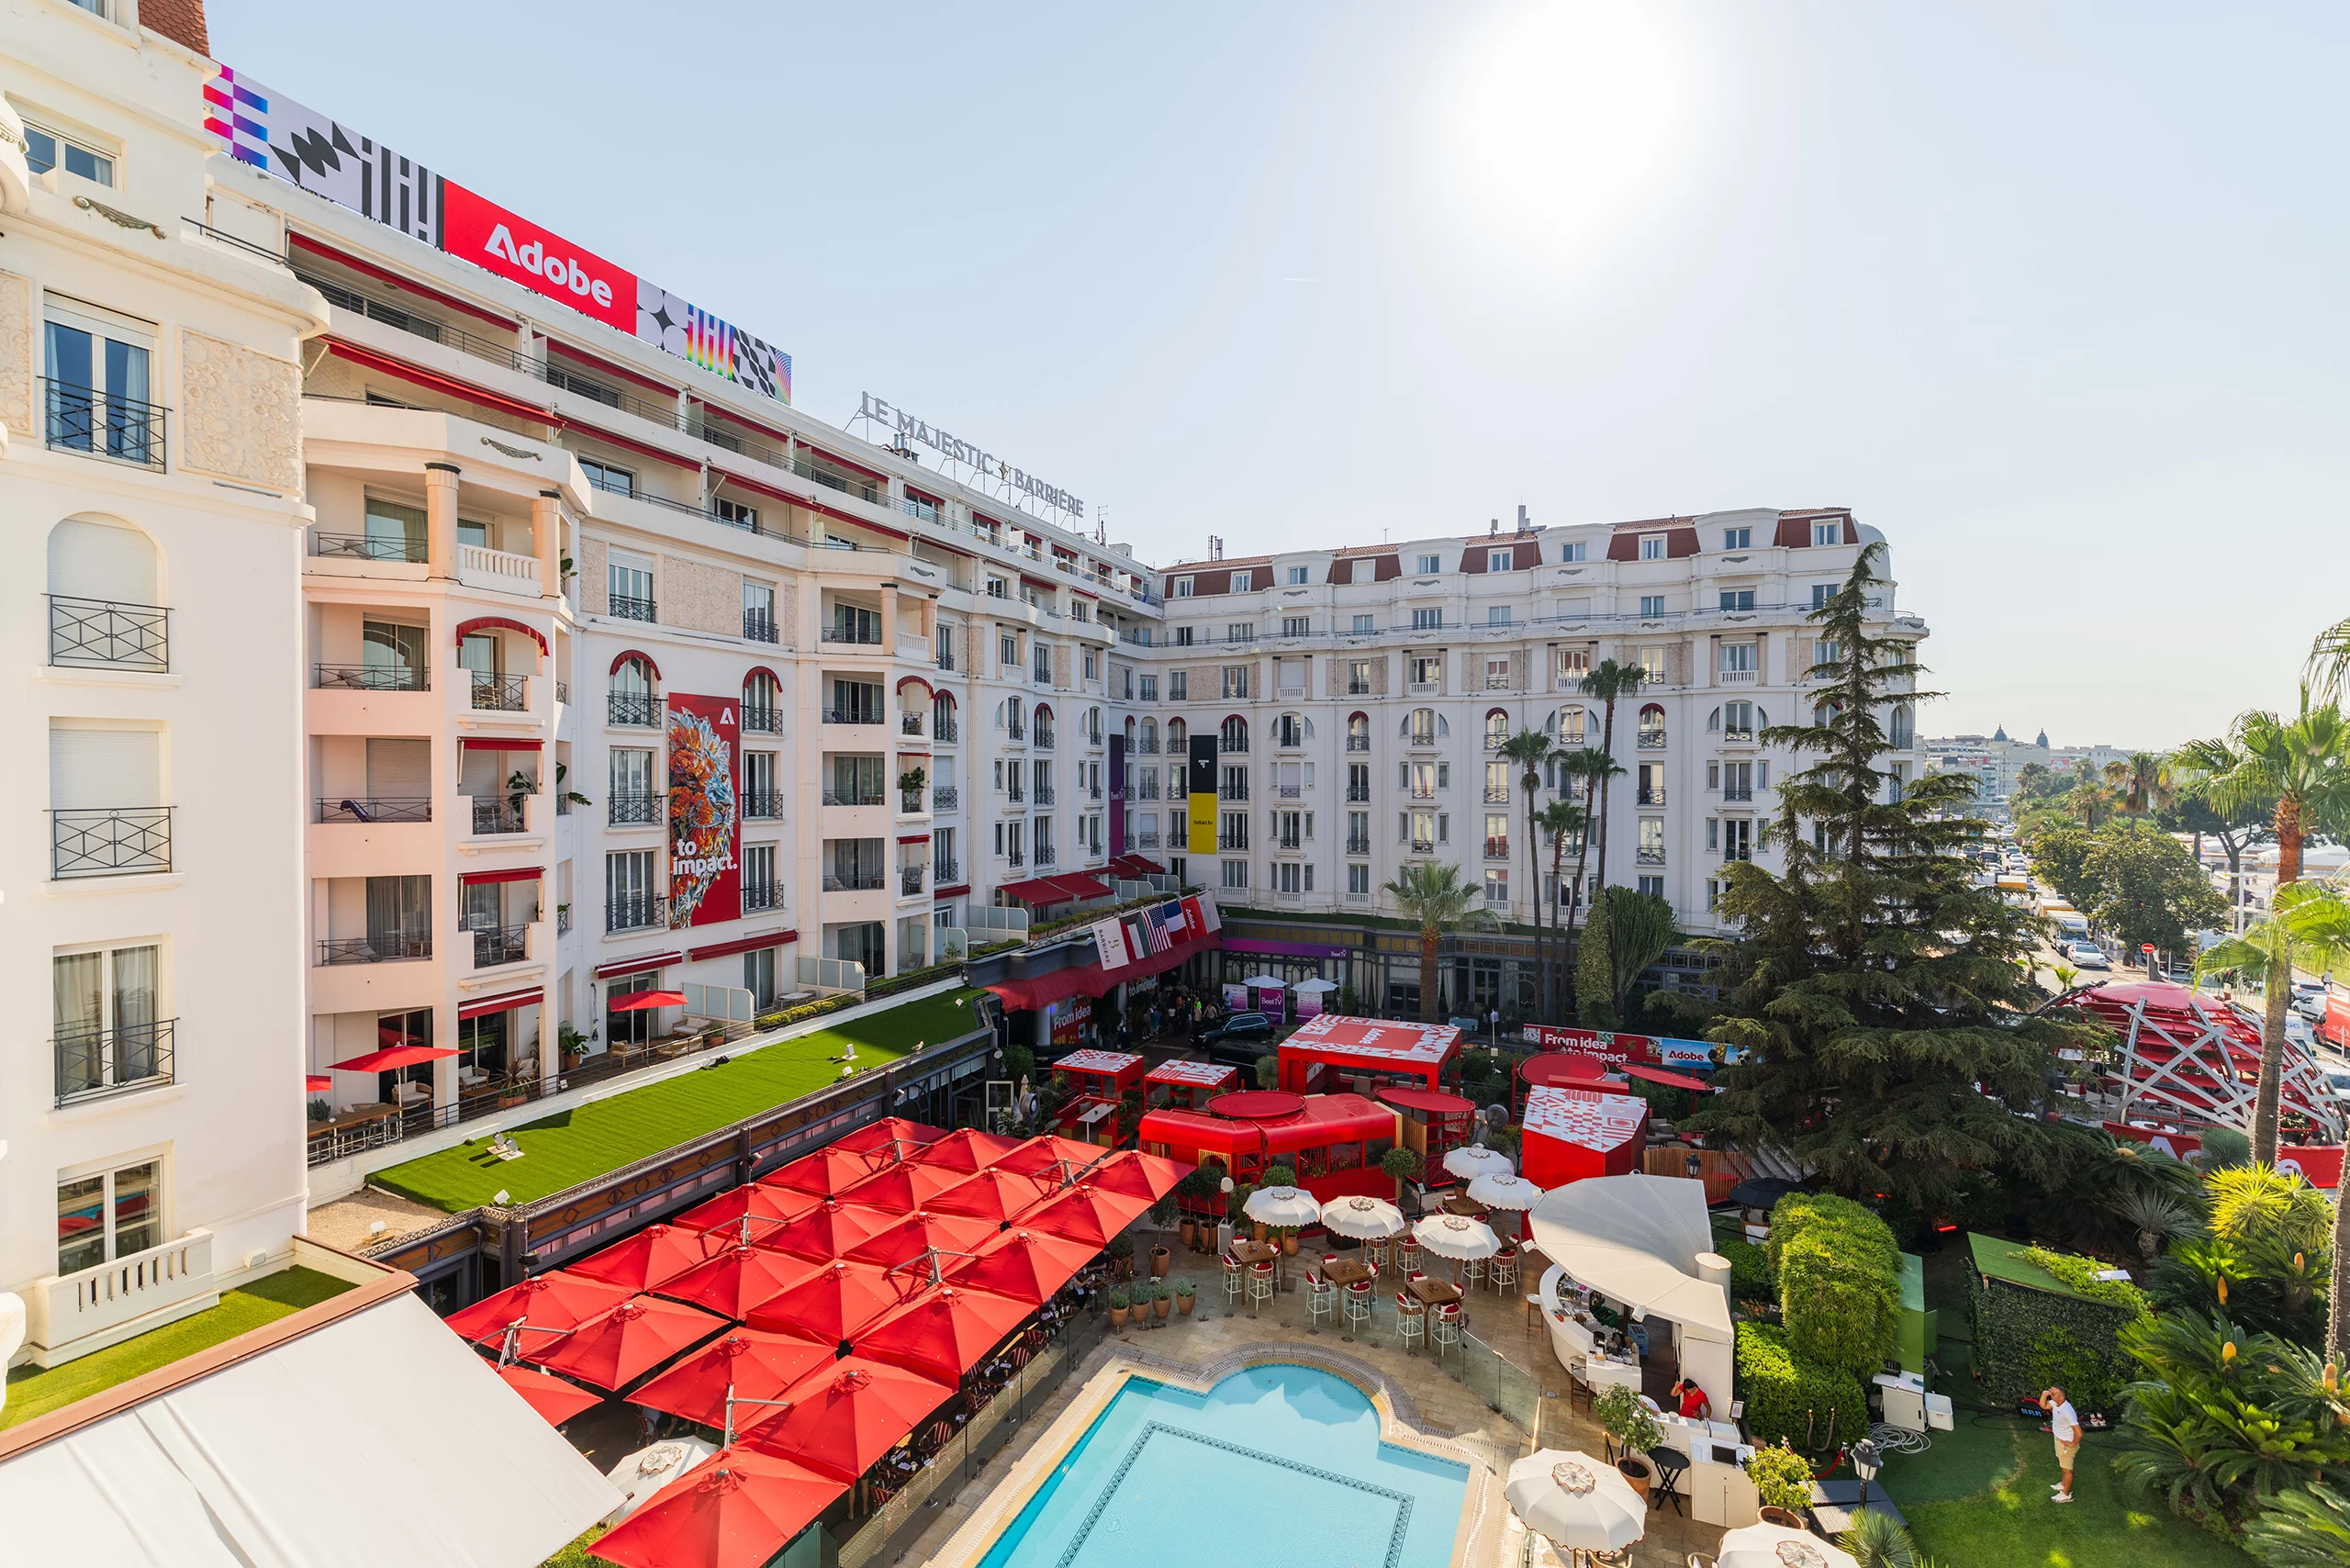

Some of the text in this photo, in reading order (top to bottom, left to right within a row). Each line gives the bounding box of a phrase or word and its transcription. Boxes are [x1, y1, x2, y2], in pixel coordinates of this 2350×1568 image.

[484, 223, 612, 308] Adobe
[862, 391, 1083, 518] LE MAJESTIC BARRIÈRE
[677, 839, 697, 856] to
[673, 852, 738, 877] impact.
[1185, 909, 1196, 929] Adobe
[1128, 985, 1136, 997] to
[1054, 1005, 1091, 1030] From idea
[1545, 1034, 1607, 1050] From idea
[1668, 1050, 1704, 1061] Adobe
